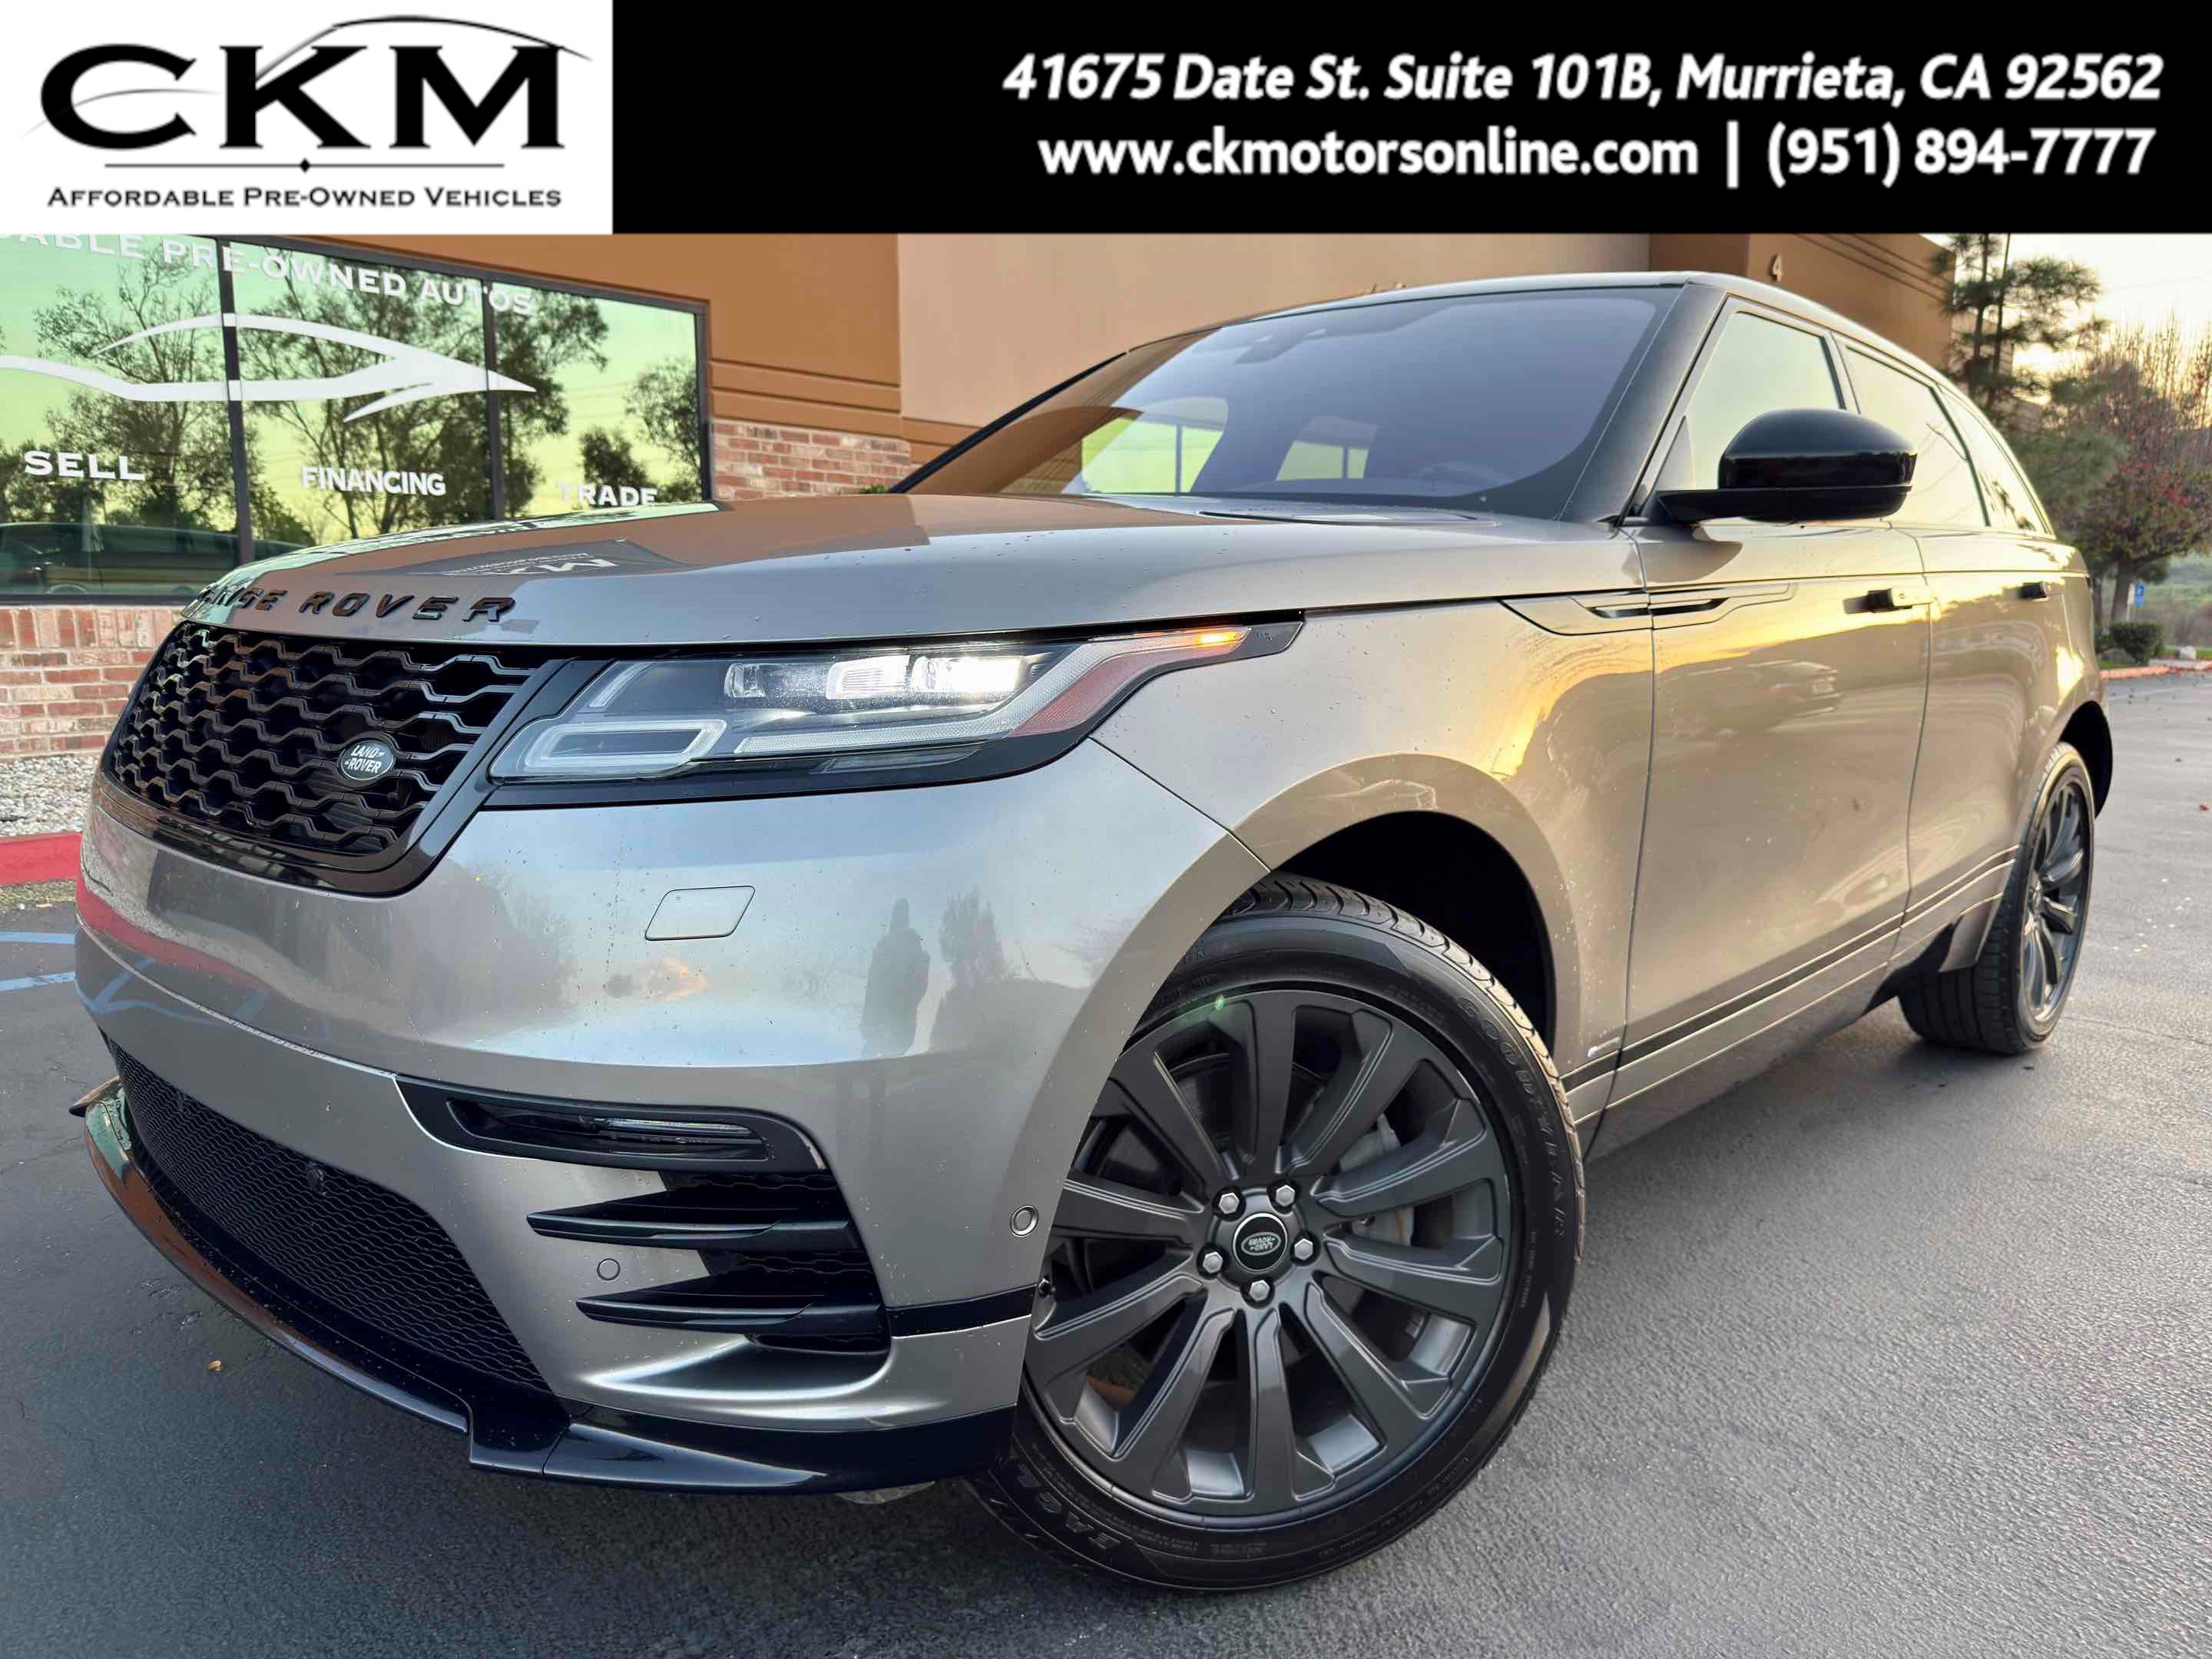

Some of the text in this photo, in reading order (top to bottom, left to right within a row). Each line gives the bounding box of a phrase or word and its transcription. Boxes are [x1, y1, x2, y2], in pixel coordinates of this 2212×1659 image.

[0, 233, 535, 316] ABLE PRE-OWNED AUTOS
[1768, 253, 1783, 283] 4
[24, 450, 146, 481] SELL
[302, 466, 446, 495] FINANCING
[556, 480, 658, 506] TRADE
[299, 589, 517, 622] ROVER
[346, 757, 382, 773] ROVER
[350, 744, 379, 759] LAND
